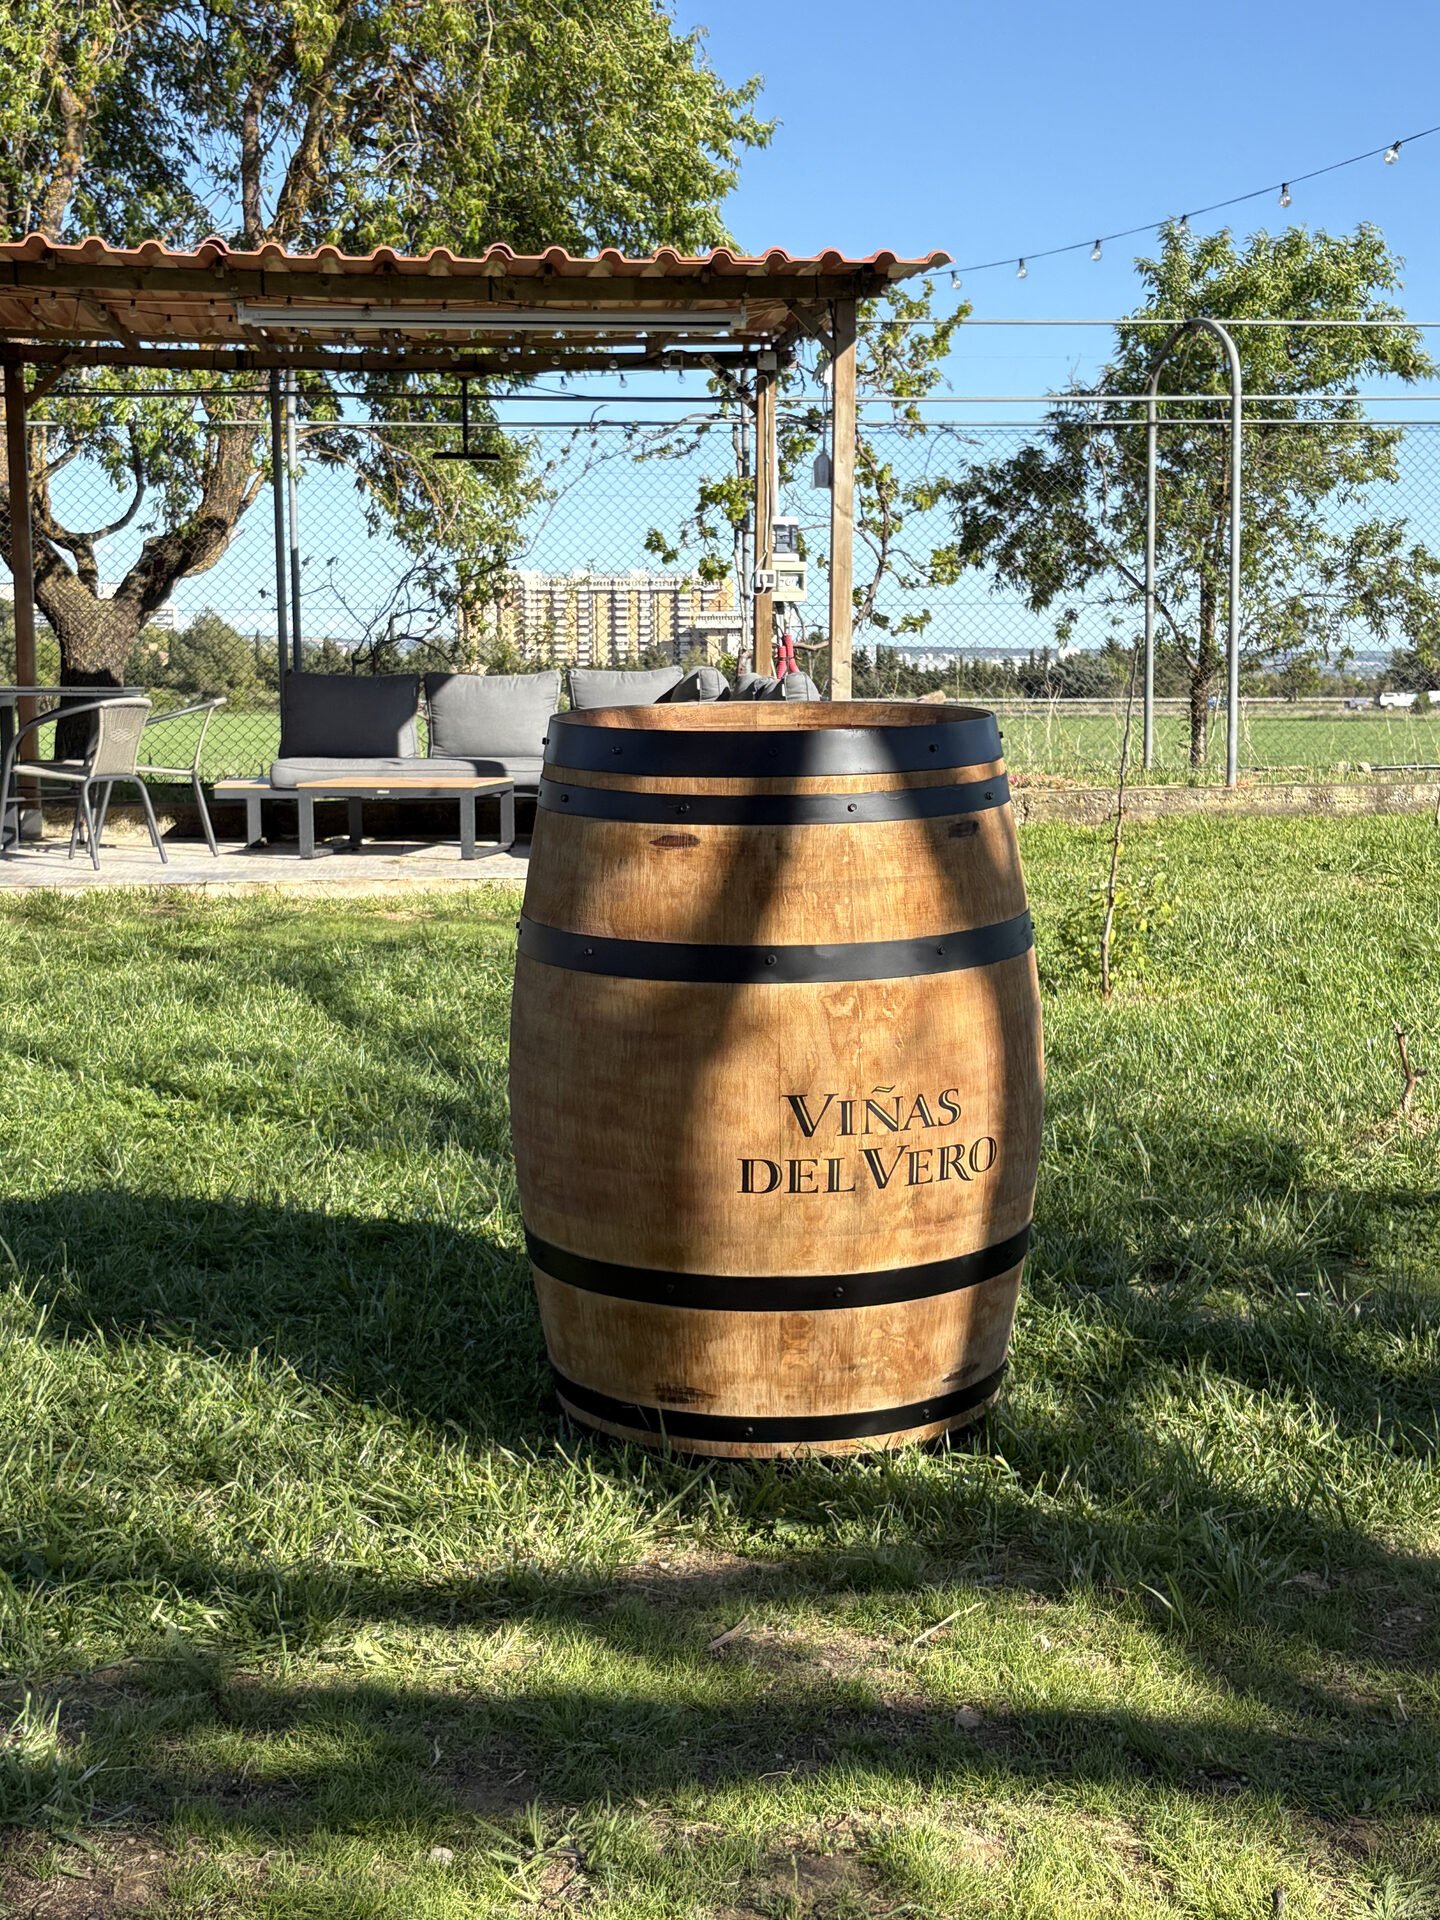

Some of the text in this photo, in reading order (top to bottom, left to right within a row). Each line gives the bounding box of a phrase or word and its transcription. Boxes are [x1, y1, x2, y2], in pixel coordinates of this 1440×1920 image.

[782, 1085, 962, 1138] VIÑAS
[737, 1136, 998, 1194] DEL VERO
